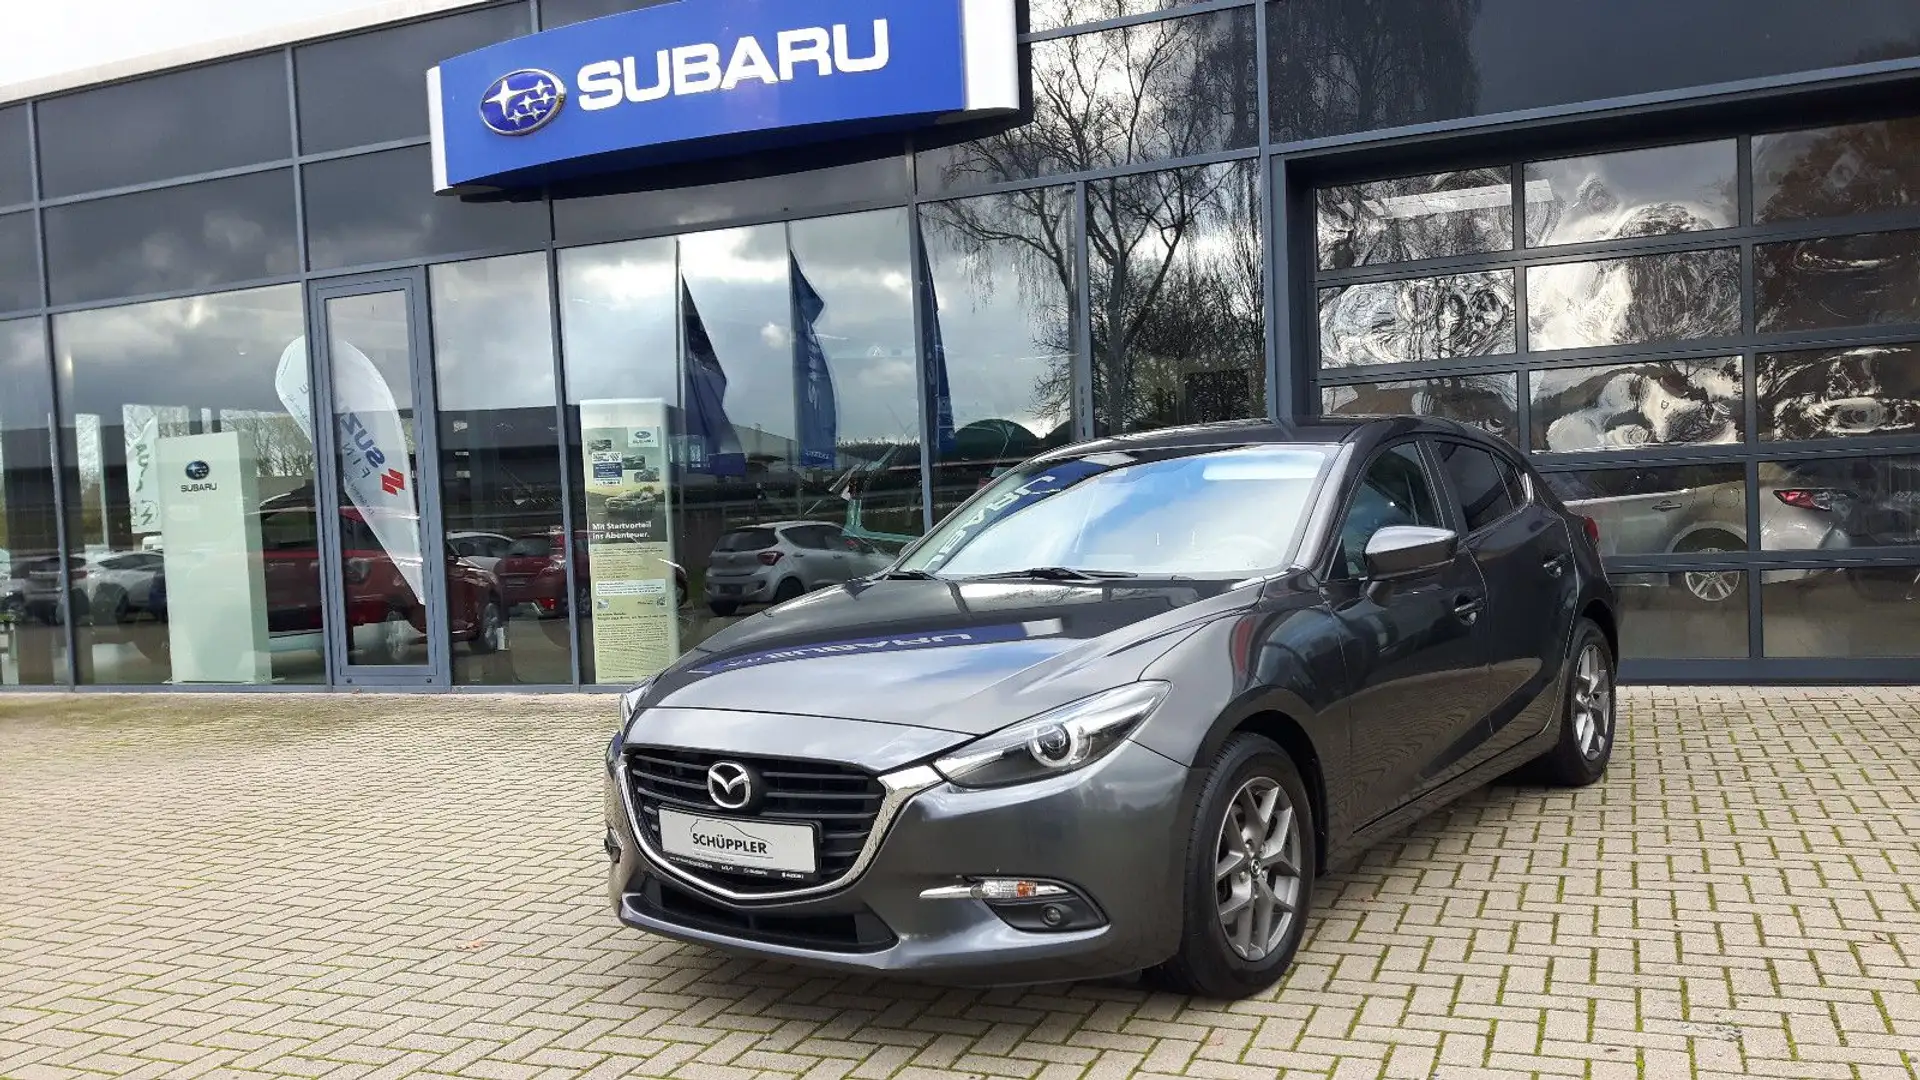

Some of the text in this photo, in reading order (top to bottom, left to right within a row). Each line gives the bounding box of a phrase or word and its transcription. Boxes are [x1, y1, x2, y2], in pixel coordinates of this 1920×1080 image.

[577, 19, 889, 111] SUBARU
[181, 483, 217, 492] SUBARU
[606, 520, 651, 529] Startvorteil
[692, 833, 767, 854] SCHÜPPLER
